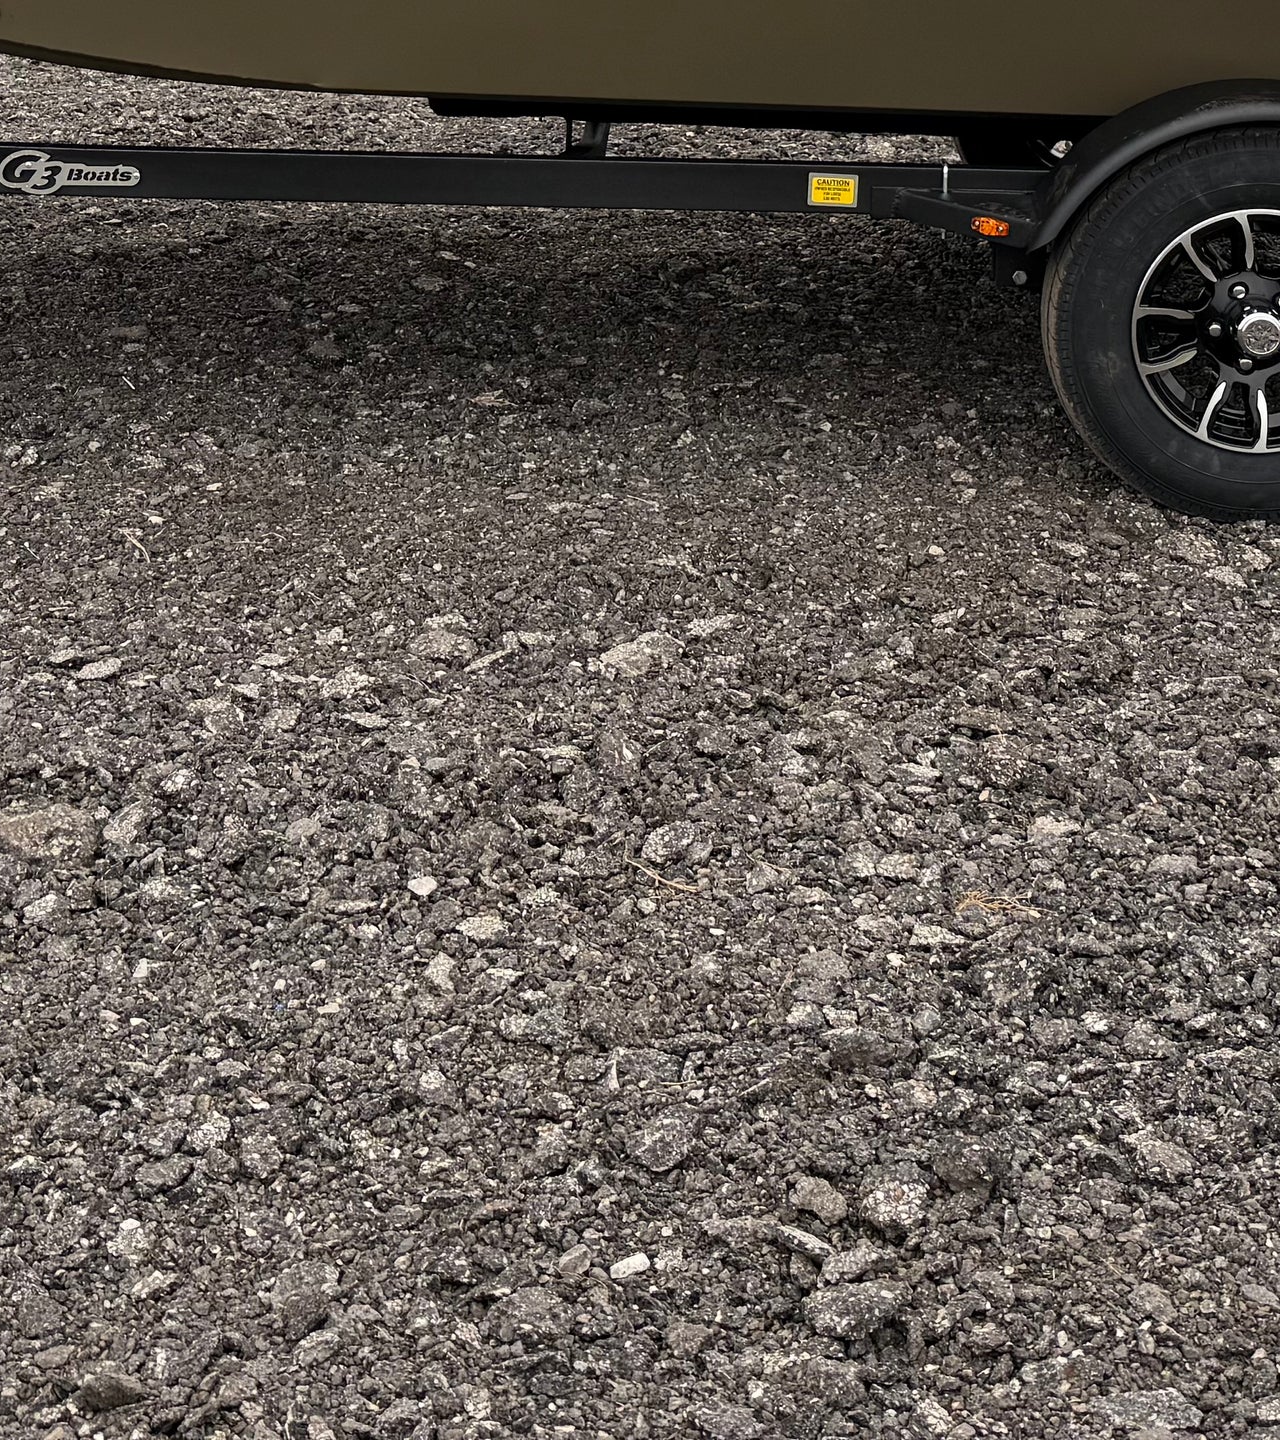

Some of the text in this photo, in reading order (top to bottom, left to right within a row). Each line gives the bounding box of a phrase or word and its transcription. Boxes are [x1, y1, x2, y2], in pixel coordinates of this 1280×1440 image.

[1, 154, 133, 191] G3 Boats
[817, 178, 850, 187] CAUTION
